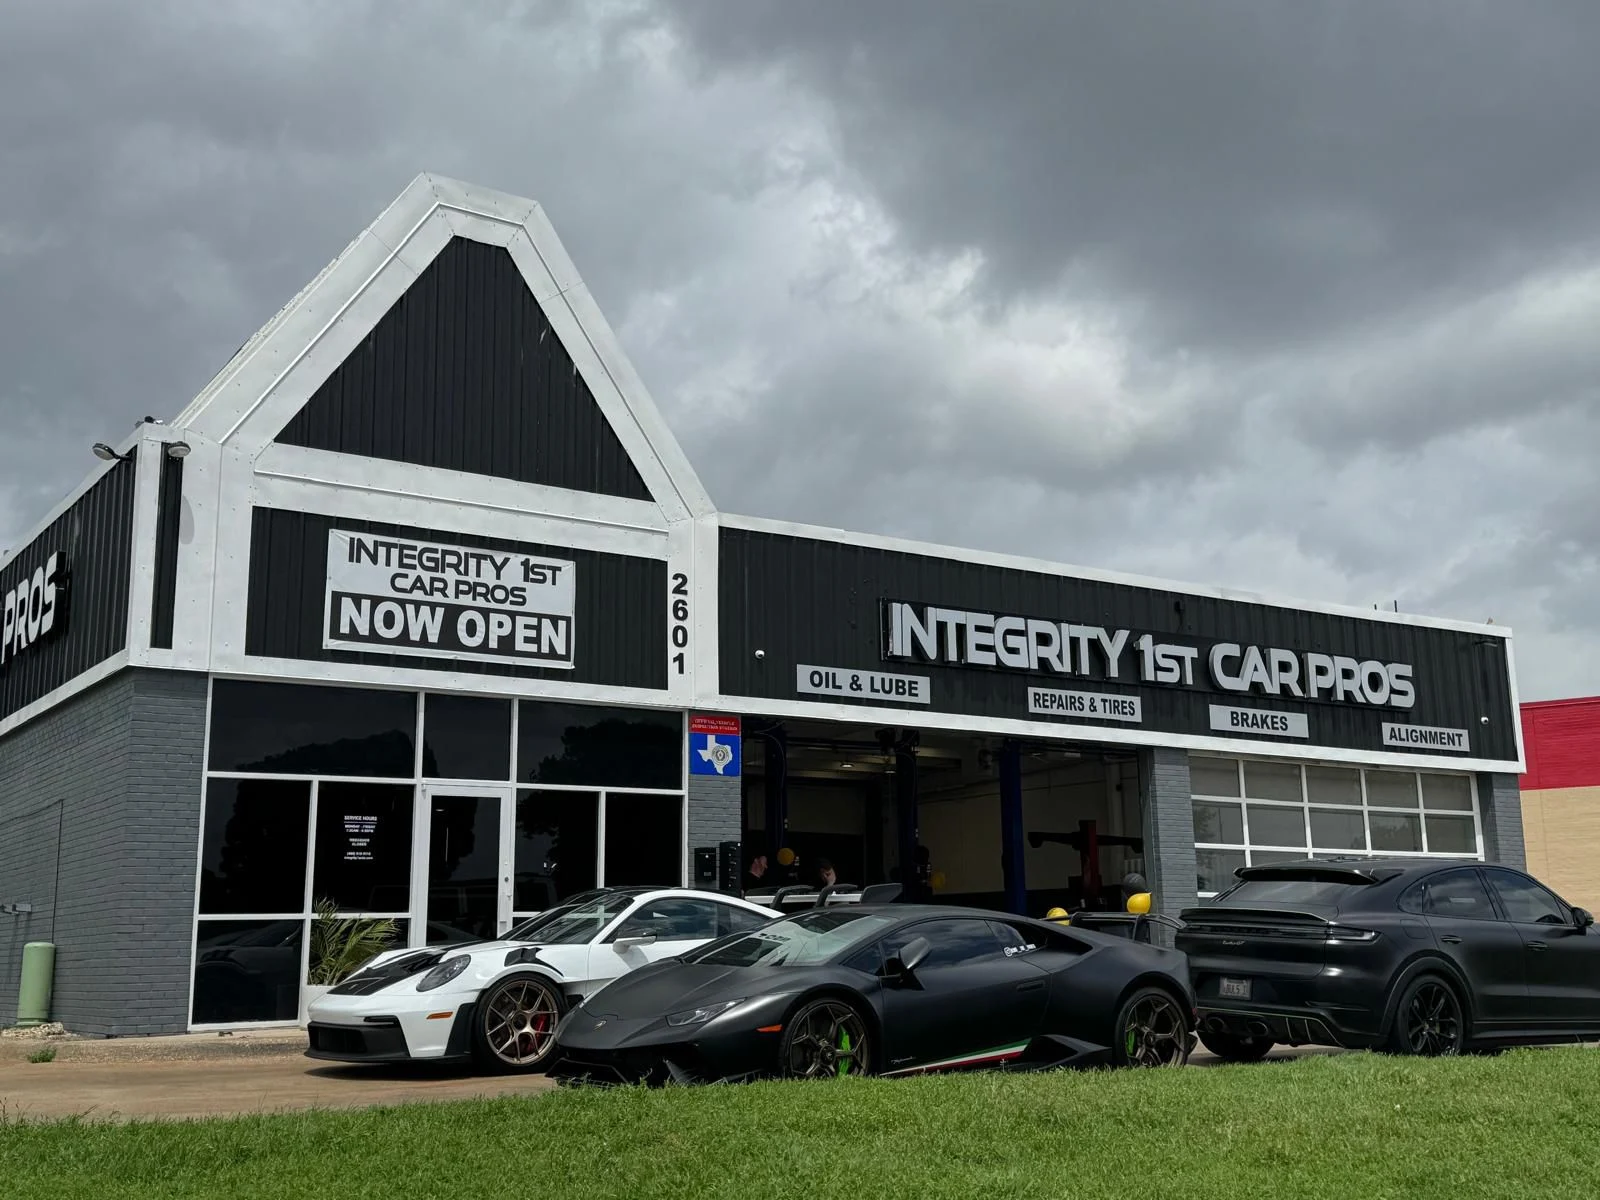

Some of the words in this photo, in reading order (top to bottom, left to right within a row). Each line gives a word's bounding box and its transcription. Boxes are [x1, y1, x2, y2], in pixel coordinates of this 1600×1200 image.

[348, 537, 511, 581] INTEGRITY
[520, 557, 562, 586] 1ST
[1, 551, 58, 664] PROS
[390, 573, 449, 599] CAR
[454, 579, 527, 607] PROS
[339, 597, 445, 643] NOW
[457, 610, 567, 656] OPEN
[672, 573, 688, 674] 2601
[888, 602, 1131, 678] INTEGRITY
[1134, 634, 1198, 685] 1ST
[1209, 643, 1304, 697] CAR
[1302, 652, 1416, 708] PROS
[809, 670, 842, 690] OIL
[849, 674, 863, 692] &
[870, 676, 919, 697] LUBE
[1033, 692, 1085, 712] REPAIRS
[1089, 699, 1098, 713] &
[1101, 698, 1136, 716] TIRES
[1230, 711, 1288, 731] BRAKES
[1389, 727, 1463, 747] ALIGNMENT
